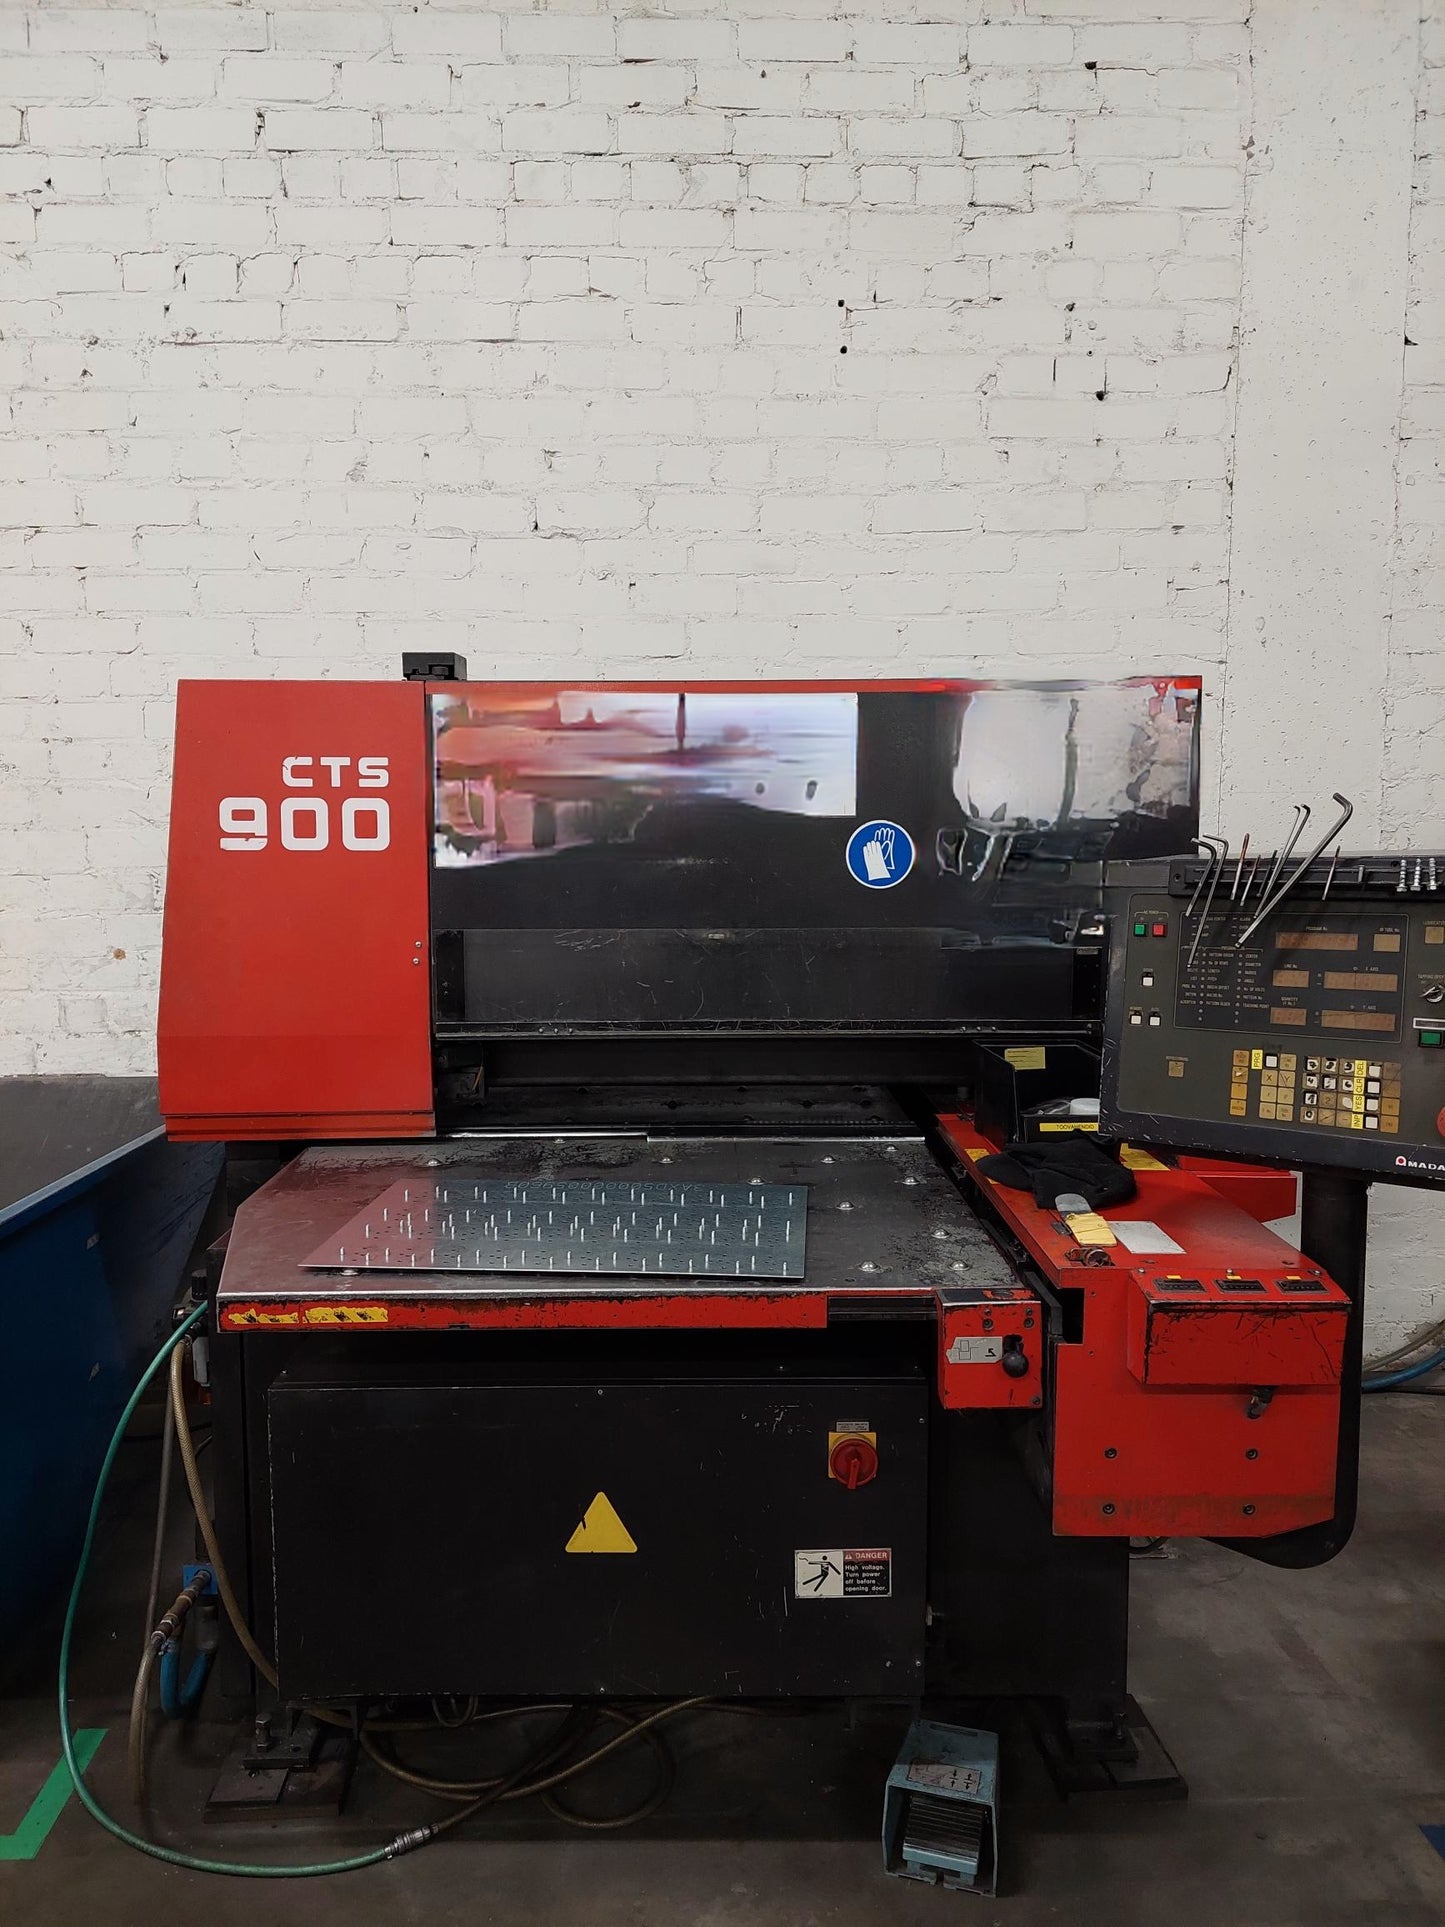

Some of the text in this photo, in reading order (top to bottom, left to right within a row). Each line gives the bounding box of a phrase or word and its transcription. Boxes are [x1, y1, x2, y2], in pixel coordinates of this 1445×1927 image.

[282, 756, 389, 788] CTS
[219, 796, 391, 851] 900
[1395, 1155, 1445, 1171] AMADA
